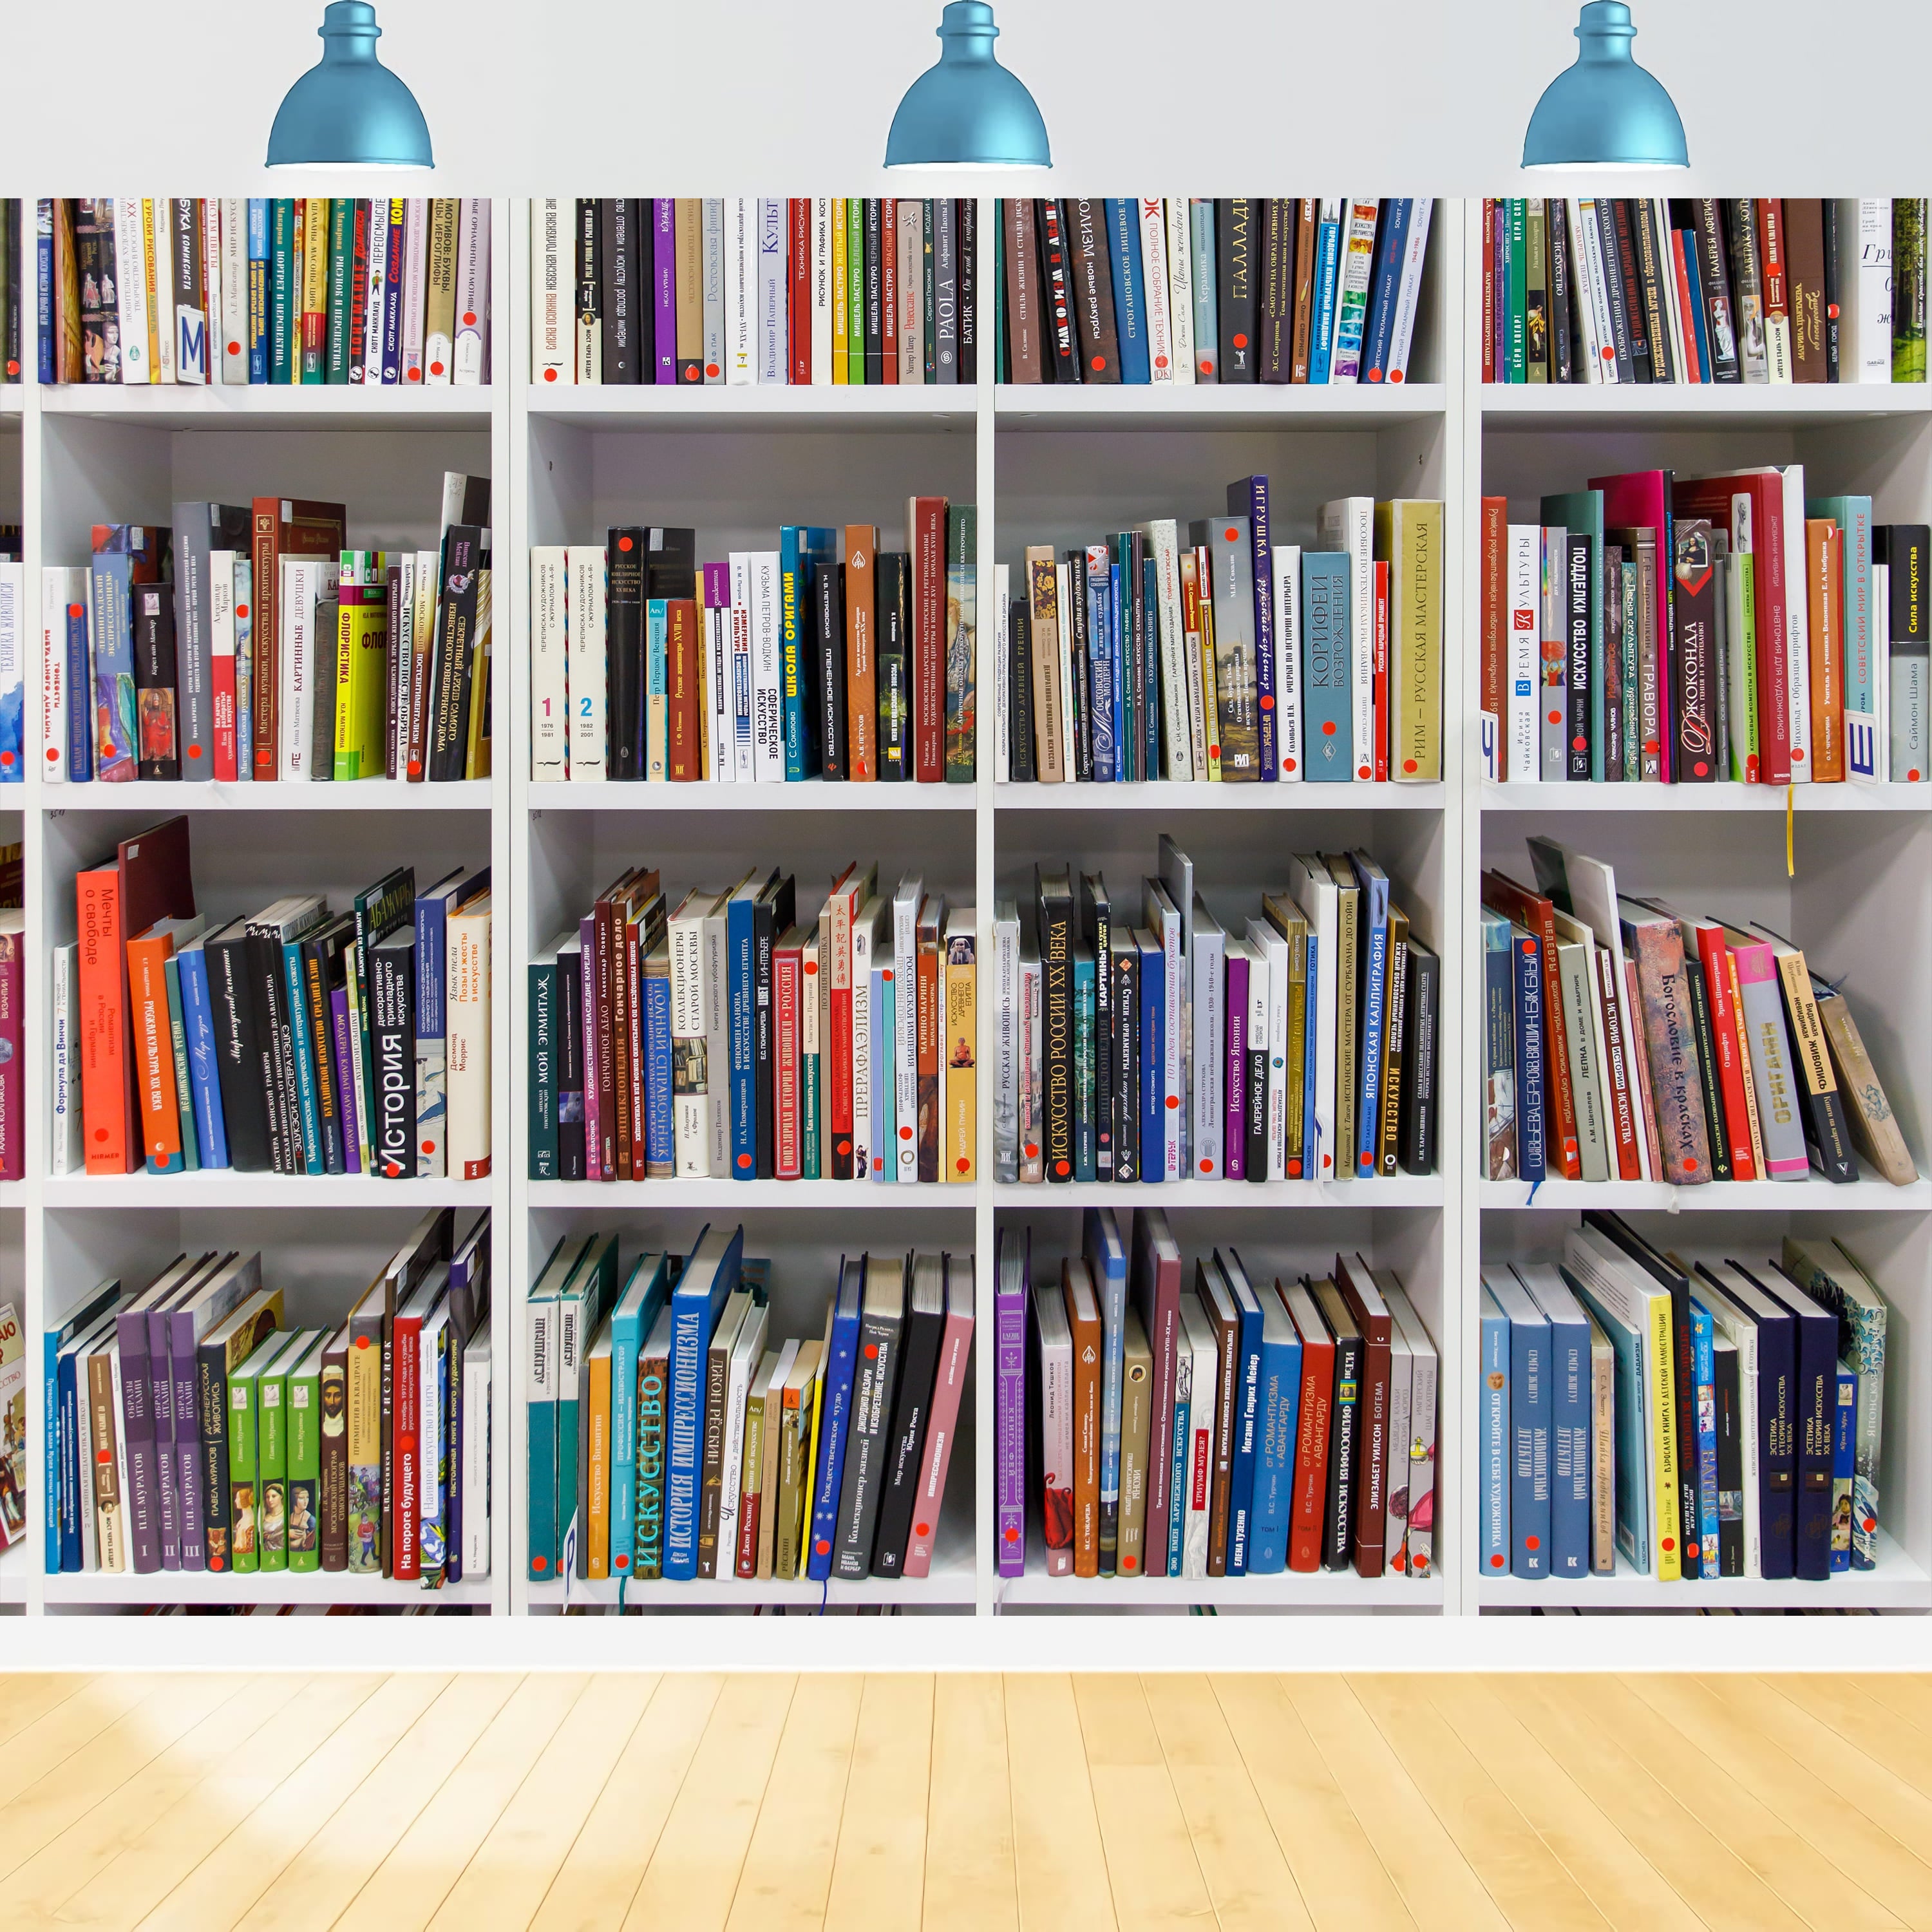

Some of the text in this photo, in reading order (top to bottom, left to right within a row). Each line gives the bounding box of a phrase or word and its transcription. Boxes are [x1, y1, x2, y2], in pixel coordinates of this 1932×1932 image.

[182, 236, 192, 289] КОМИКСИСТА
[276, 251, 285, 290] ПОРТРЕТ
[1119, 207, 1136, 338] СТРОГАНОВСКОЕ ЛИЦЕВОЕ
[1197, 254, 1211, 303] Керамика
[1706, 236, 1721, 278] ГАЛЕРЕЯ
[275, 303, 285, 365] ПЕРСПЕКТИВА
[352, 264, 365, 355] ПОНИМАНИЕ
[766, 279, 776, 377] ВЛАДИМИР ПАПЕРНЫЙ
[939, 278, 954, 339] PAOLA
[963, 306, 972, 344] БАТИК
[1086, 261, 1100, 339] новые ракурсы
[1513, 314, 1522, 343] ХОГАРТ
[1613, 301, 1627, 361] ИЗОБРАЖЕНИЯ
[370, 334, 379, 353] СКОТТ
[1255, 485, 1267, 557] ИГРУШКА
[1855, 513, 1866, 572] ОТКРЫТКЕ
[259, 542, 270, 601] архитектуры
[712, 569, 722, 605] gaudeamus
[1073, 558, 1084, 607] художника
[1857, 585, 1866, 613] МИР
[1908, 547, 1919, 633] Сила искусства
[259, 613, 270, 658] искусства
[292, 569, 305, 692] КАРТИННЫЕ ДЕВУШКИ
[340, 612, 351, 683] ФЛОРИСТИКА
[784, 572, 797, 697] ШКОЛА ОРИГАМИ
[1016, 618, 1025, 655] ГРЕЦИИ
[1311, 574, 1329, 689] КОРИФЕИ
[1332, 574, 1345, 688] ВОЗРОЖДЕНИЯ
[1414, 522, 1428, 759] РИМ РУССКАЯ МАСТЕРСКАЯ
[1514, 538, 1531, 692] ВРЕМЯ КУЛЬТУРЫ
[1856, 617, 1868, 684] СОВЕТСКИЙ
[1573, 619, 1588, 690] ИСКУССТВО
[1681, 622, 1712, 754] ДЖОКОНДА
[1789, 614, 1803, 748] Чихольд Образцы шрифтов
[259, 696, 270, 734] Мастера
[542, 698, 551, 716] 1
[580, 698, 592, 716] 2
[757, 688, 767, 744] ИСКУССТВО
[768, 688, 779, 759] СФЕРИЧЕСКОЕ
[1643, 665, 1655, 736] ГРАВЮРА
[1907, 663, 1920, 750] Саймон Шама
[85, 889, 99, 965] о свободе
[100, 889, 114, 936] Мечты
[460, 933, 469, 965] жесты
[469, 944, 479, 994] искусстве
[674, 931, 687, 1030] КОЛЛЕКЦИОНЕРЫ
[689, 931, 700, 1030] СТАРОЙ МОСКВЫ
[384, 961, 395, 1027] прикладного
[395, 974, 406, 1025] искусства
[460, 976, 469, 1002] Позы
[536, 973, 551, 1046] ЭРМИТАЖ
[1365, 934, 1384, 1099] ЯПОНСКАЯ КАЛЛИГРАФИЯ
[613, 918, 627, 1142] ЭНЦИКЛОПЕДИЯ Гончарное дело
[855, 984, 869, 1119] ПРЕРАФАЭЛИЗМ
[1049, 920, 1068, 1159] ИСКУССТВО РОССИИ XX ВЕКА
[1230, 1016, 1242, 1112] Искусство Японии
[1660, 974, 1683, 1065] Богословие
[1674, 1085, 1694, 1148] красках
[55, 1019, 67, 1114] Формула да Винчи
[1253, 1055, 1264, 1135] ГАЛЕРЕЙНОЕ ДЕЛО
[1759, 1021, 1792, 1124] ОРИГАМИ
[127, 1381, 135, 1419] ОБРАЗЫ
[135, 1380, 144, 1417] ИТАЛИИ
[668, 1312, 699, 1548] ИСТОРИЯ ИМПРЕССИОНИЗМА
[1242, 1354, 1260, 1453] Иоганн Генрих Мейер
[1491, 1393, 1502, 1447] ОТКРОЙТЕ
[135, 1453, 146, 1506] МУРАТОВ
[591, 1415, 603, 1515] Искусство Византии
[637, 1375, 662, 1567] ИСКУССТВО
[821, 1393, 843, 1503] Рождественское чудо
[928, 1432, 945, 1497] ИМПРЕССИОНИЗМ
[1370, 1381, 1383, 1510] ЭЛИЗАБЕТ УИЛСОН БОГЕМА
[1491, 1457, 1501, 1482] СЕБЕ
[400, 1454, 414, 1569] На пороге будущего
[1196, 1468, 1206, 1503] ТРИУМФ
[1491, 1484, 1502, 1547] ХУДОЖНИКА
